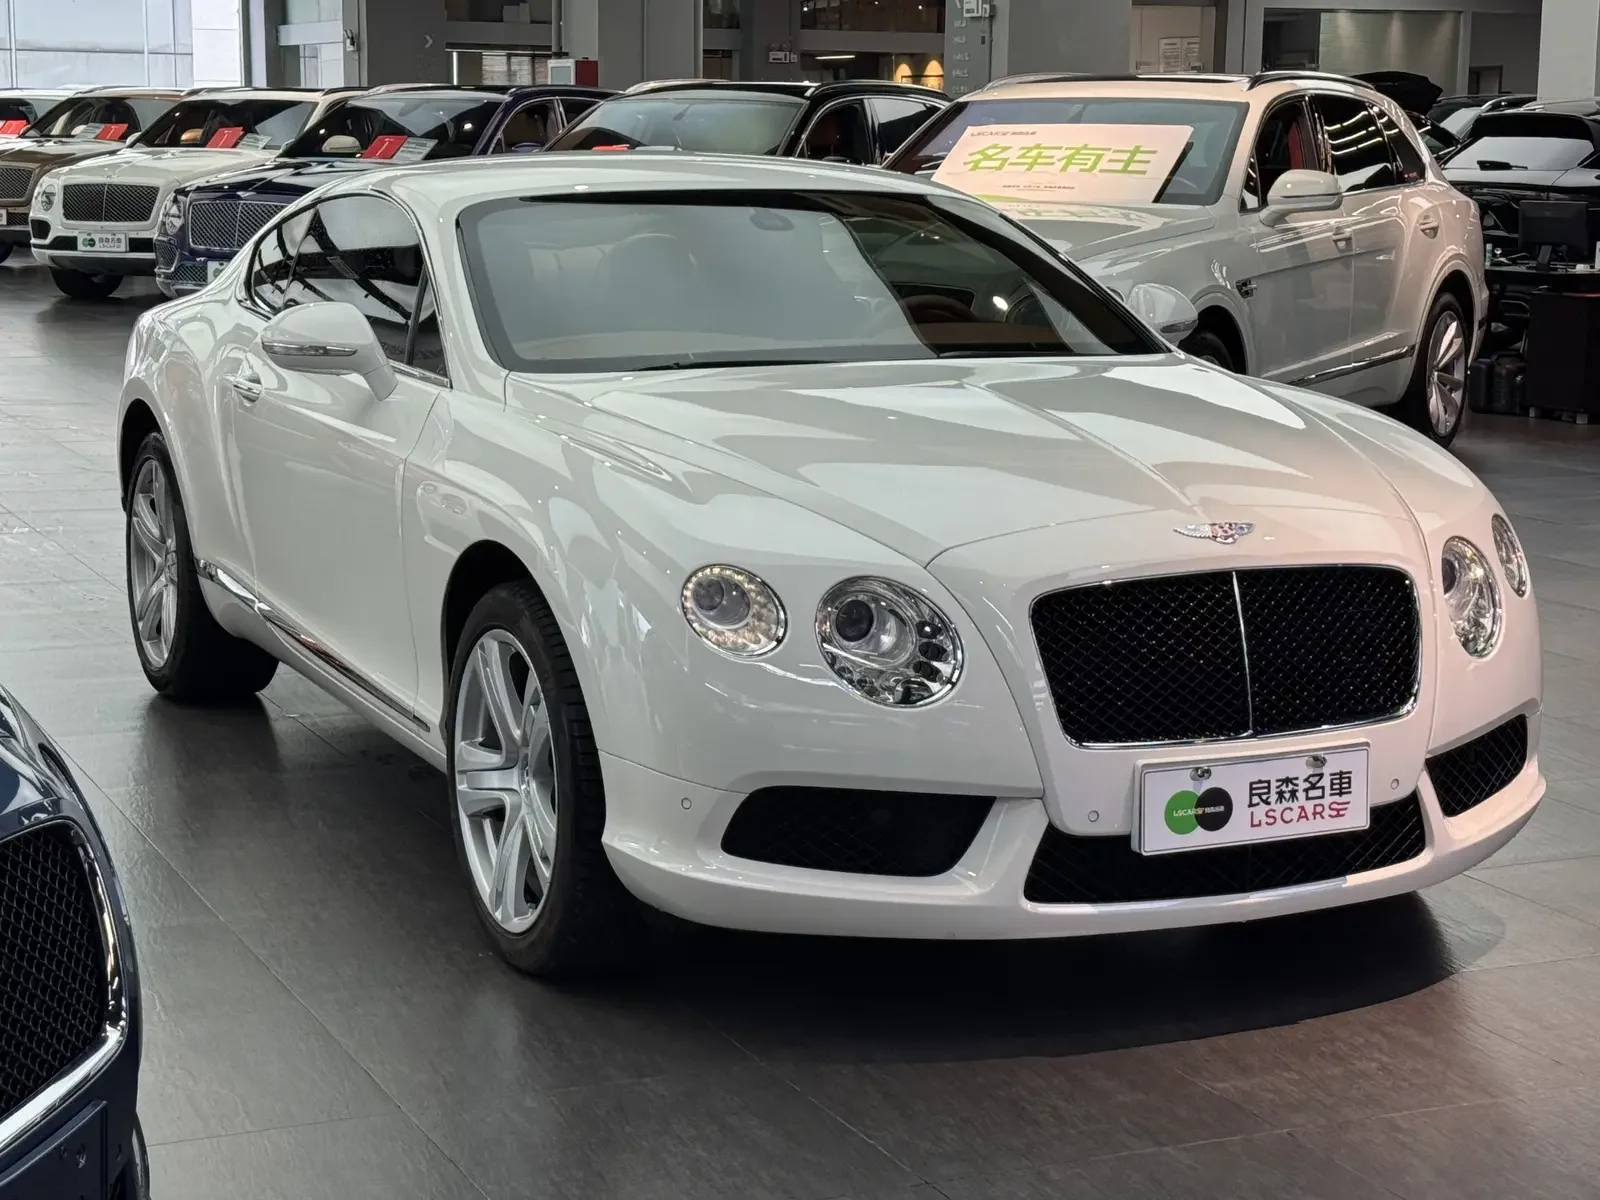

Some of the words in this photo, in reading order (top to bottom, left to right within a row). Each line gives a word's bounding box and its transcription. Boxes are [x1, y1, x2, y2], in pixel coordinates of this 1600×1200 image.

[963, 143, 1157, 175] 名车有主
[1248, 770, 1353, 808] 良森名車
